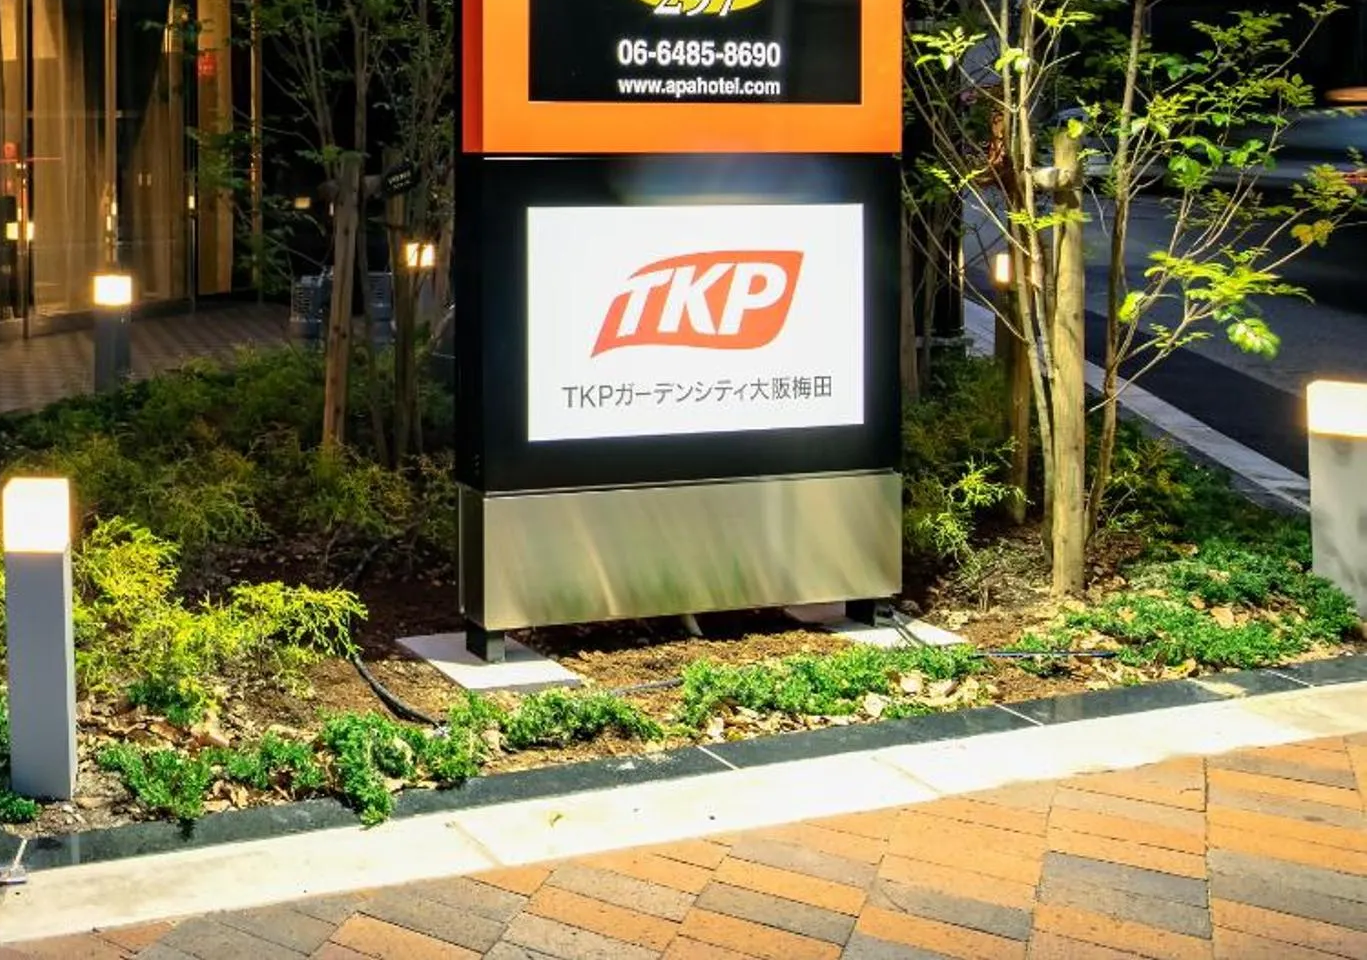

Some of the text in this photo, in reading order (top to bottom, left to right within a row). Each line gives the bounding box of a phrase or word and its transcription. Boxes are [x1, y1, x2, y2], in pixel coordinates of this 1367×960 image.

[618, 39, 781, 68] 06-6485-8690
[617, 76, 781, 99] www.apahotel.com
[615, 261, 788, 339] TKP
[561, 375, 833, 409] TKPガーデンシティ大阪梅田
